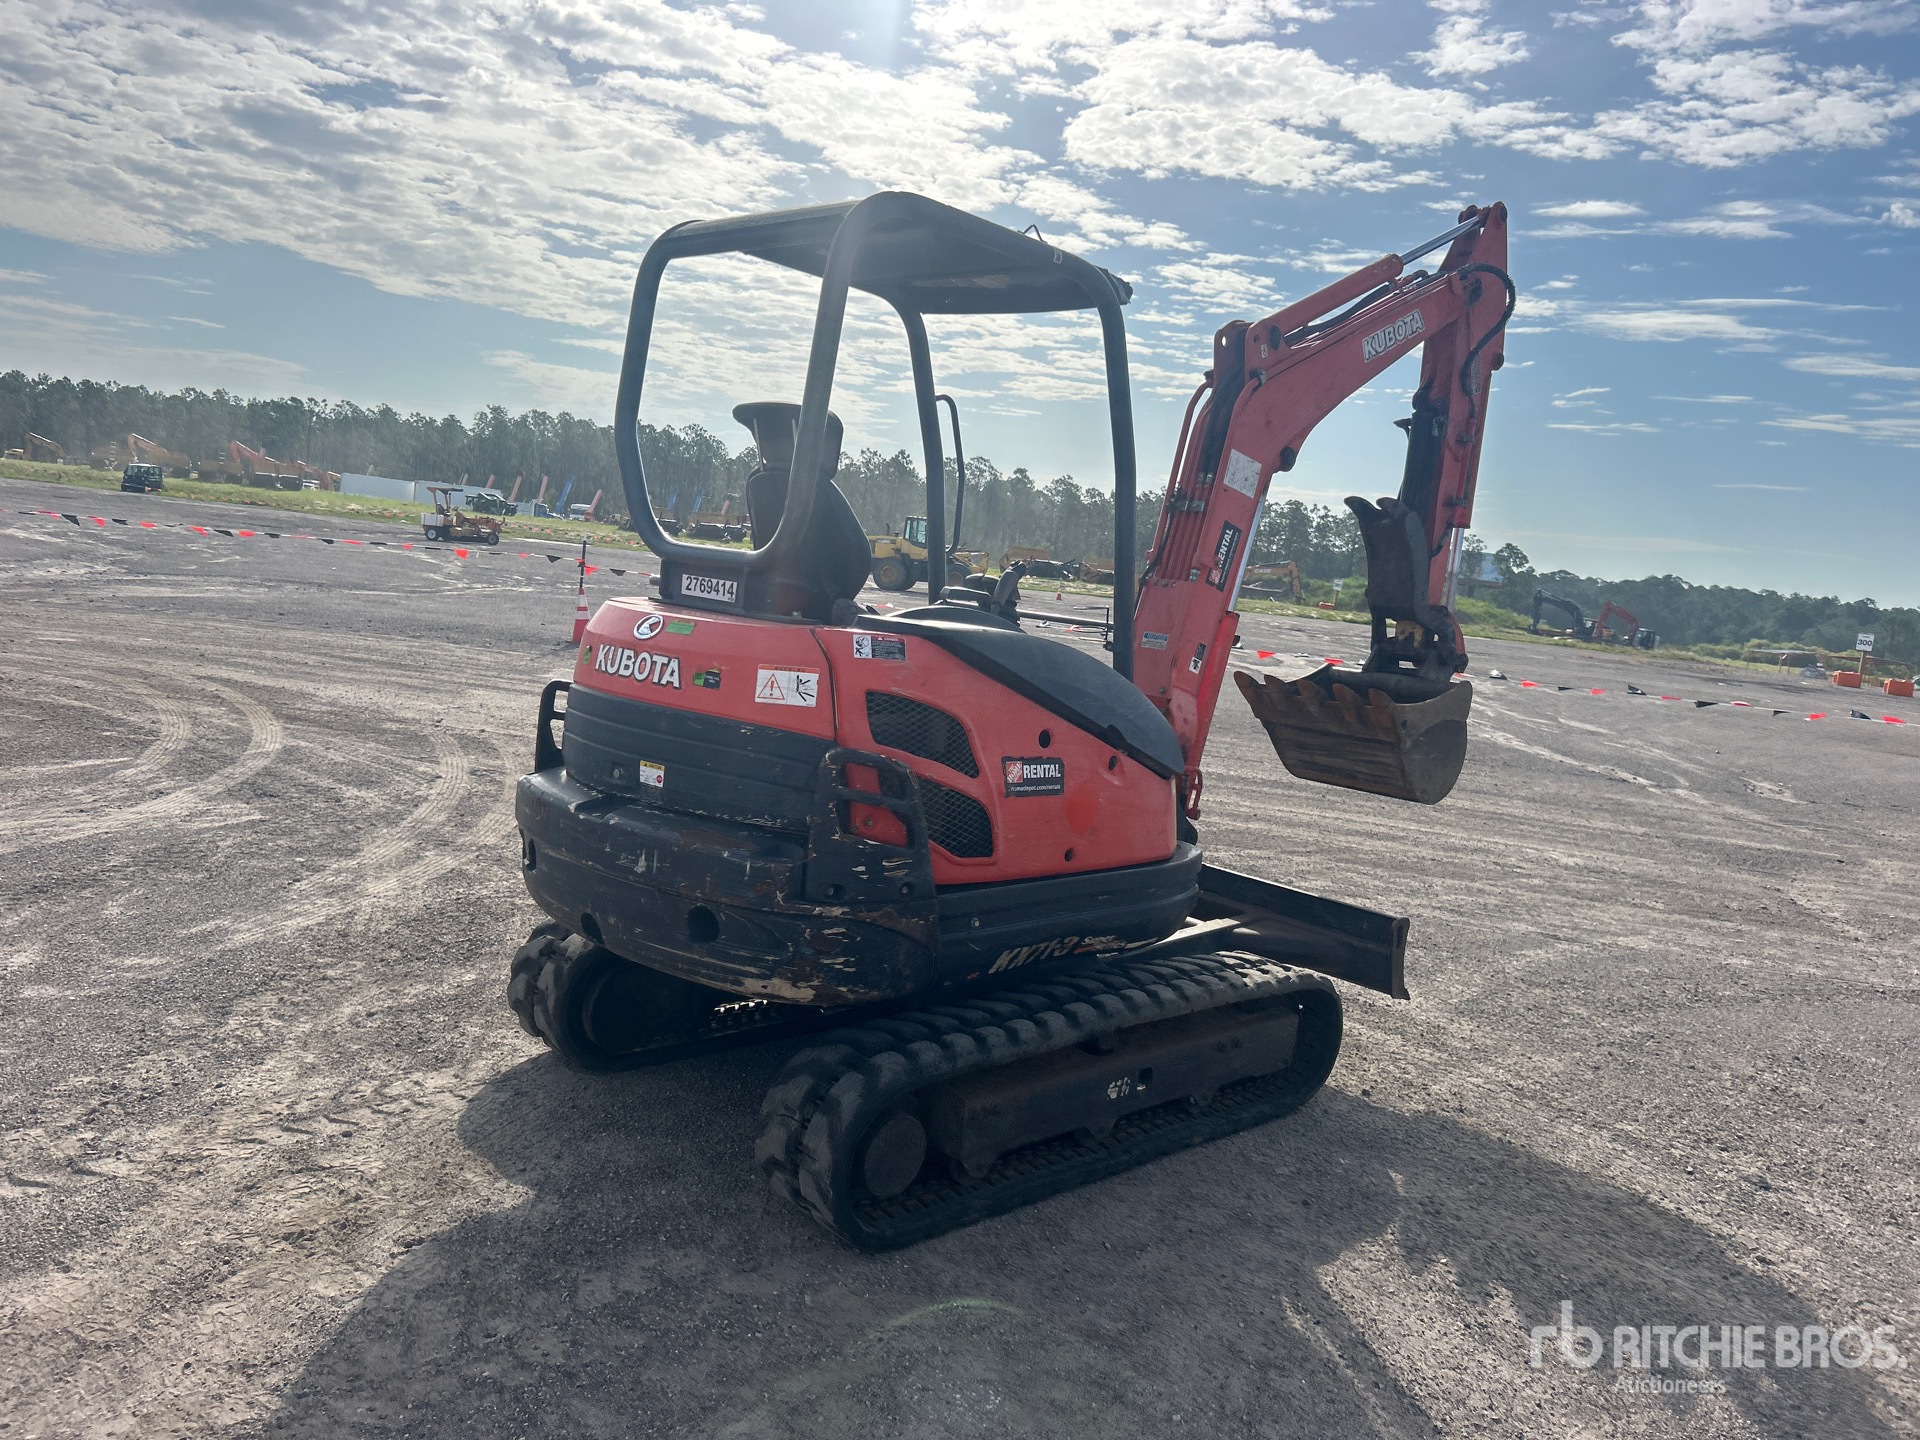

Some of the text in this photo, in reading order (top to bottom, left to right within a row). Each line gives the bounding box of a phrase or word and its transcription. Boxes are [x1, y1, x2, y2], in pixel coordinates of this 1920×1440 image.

[1363, 310, 1425, 361] KUBOTA
[685, 576, 735, 598] 2769414
[595, 643, 681, 689] KUBOTA
[1023, 764, 1061, 778] RENTAL
